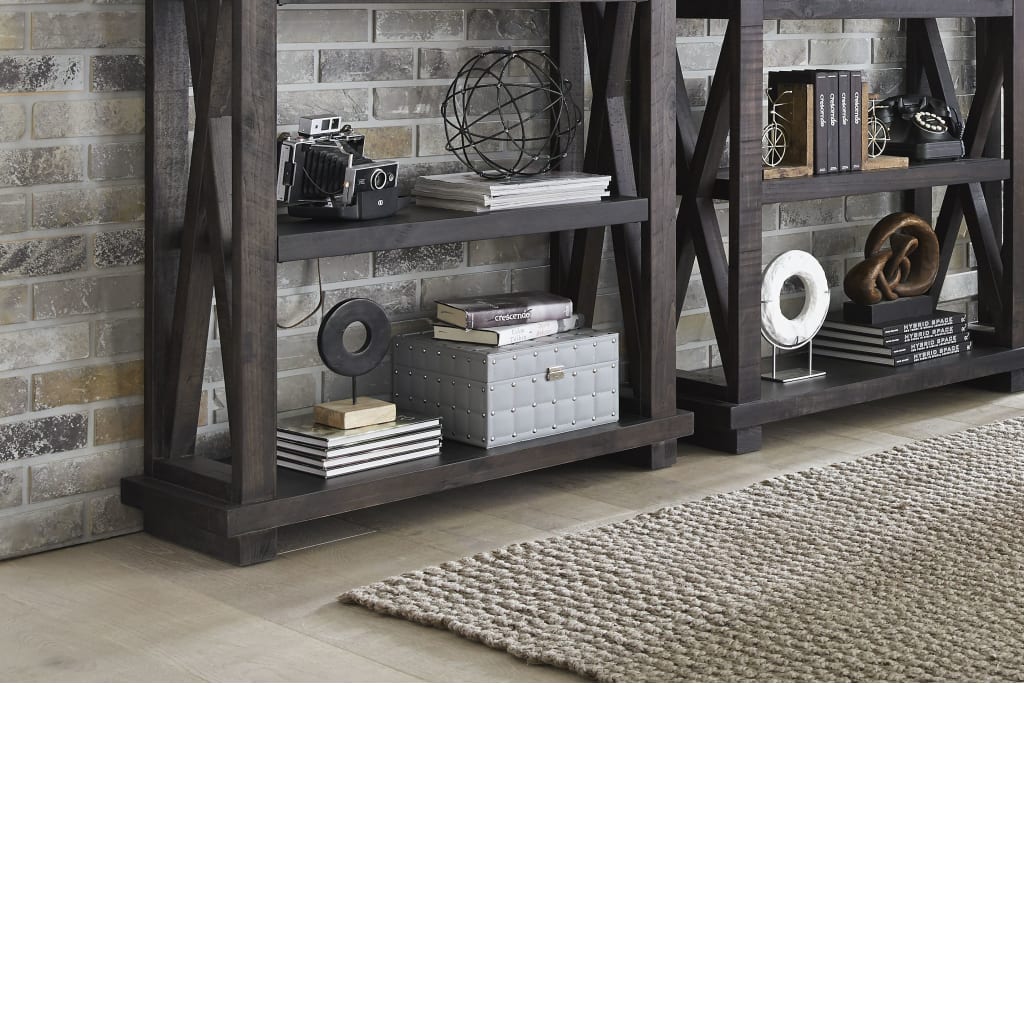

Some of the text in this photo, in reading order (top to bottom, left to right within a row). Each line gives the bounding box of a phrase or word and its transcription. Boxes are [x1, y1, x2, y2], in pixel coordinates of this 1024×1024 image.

[494, 310, 531, 322] crescendo
[903, 317, 953, 330] HYBRID SPACE
[904, 330, 930, 340] HYBRID
[932, 326, 954, 334] SPACE
[910, 340, 935, 350] HYBRID
[936, 335, 957, 344] SPACE
[913, 349, 938, 359] HYBRID
[939, 344, 960, 354] SPACE
